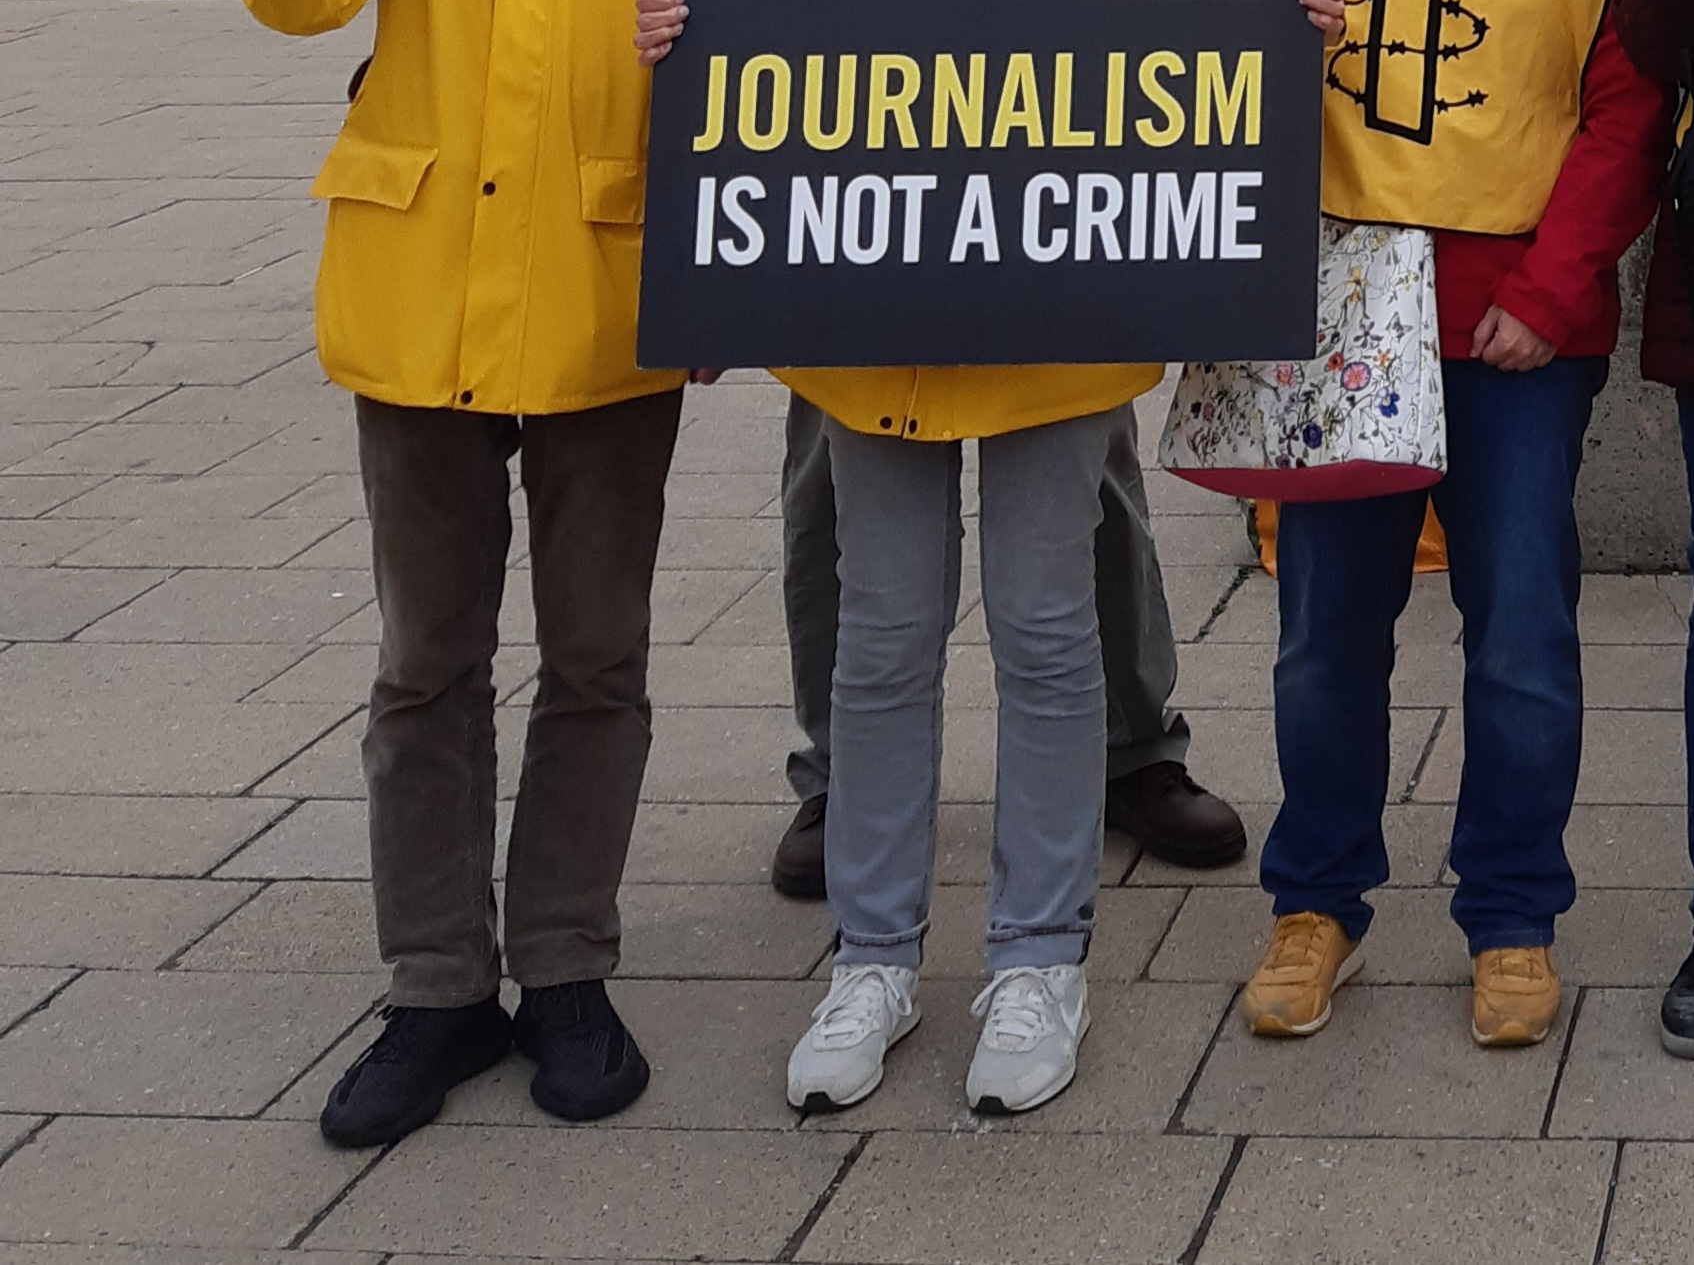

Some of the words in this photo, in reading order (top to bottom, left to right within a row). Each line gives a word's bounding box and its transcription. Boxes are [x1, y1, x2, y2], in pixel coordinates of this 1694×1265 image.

[692, 51, 1263, 152] JOURNALISM
[694, 176, 766, 266] IS
[787, 175, 937, 265] NOT
[949, 174, 1001, 263] A
[1021, 171, 1263, 263] CRIME
